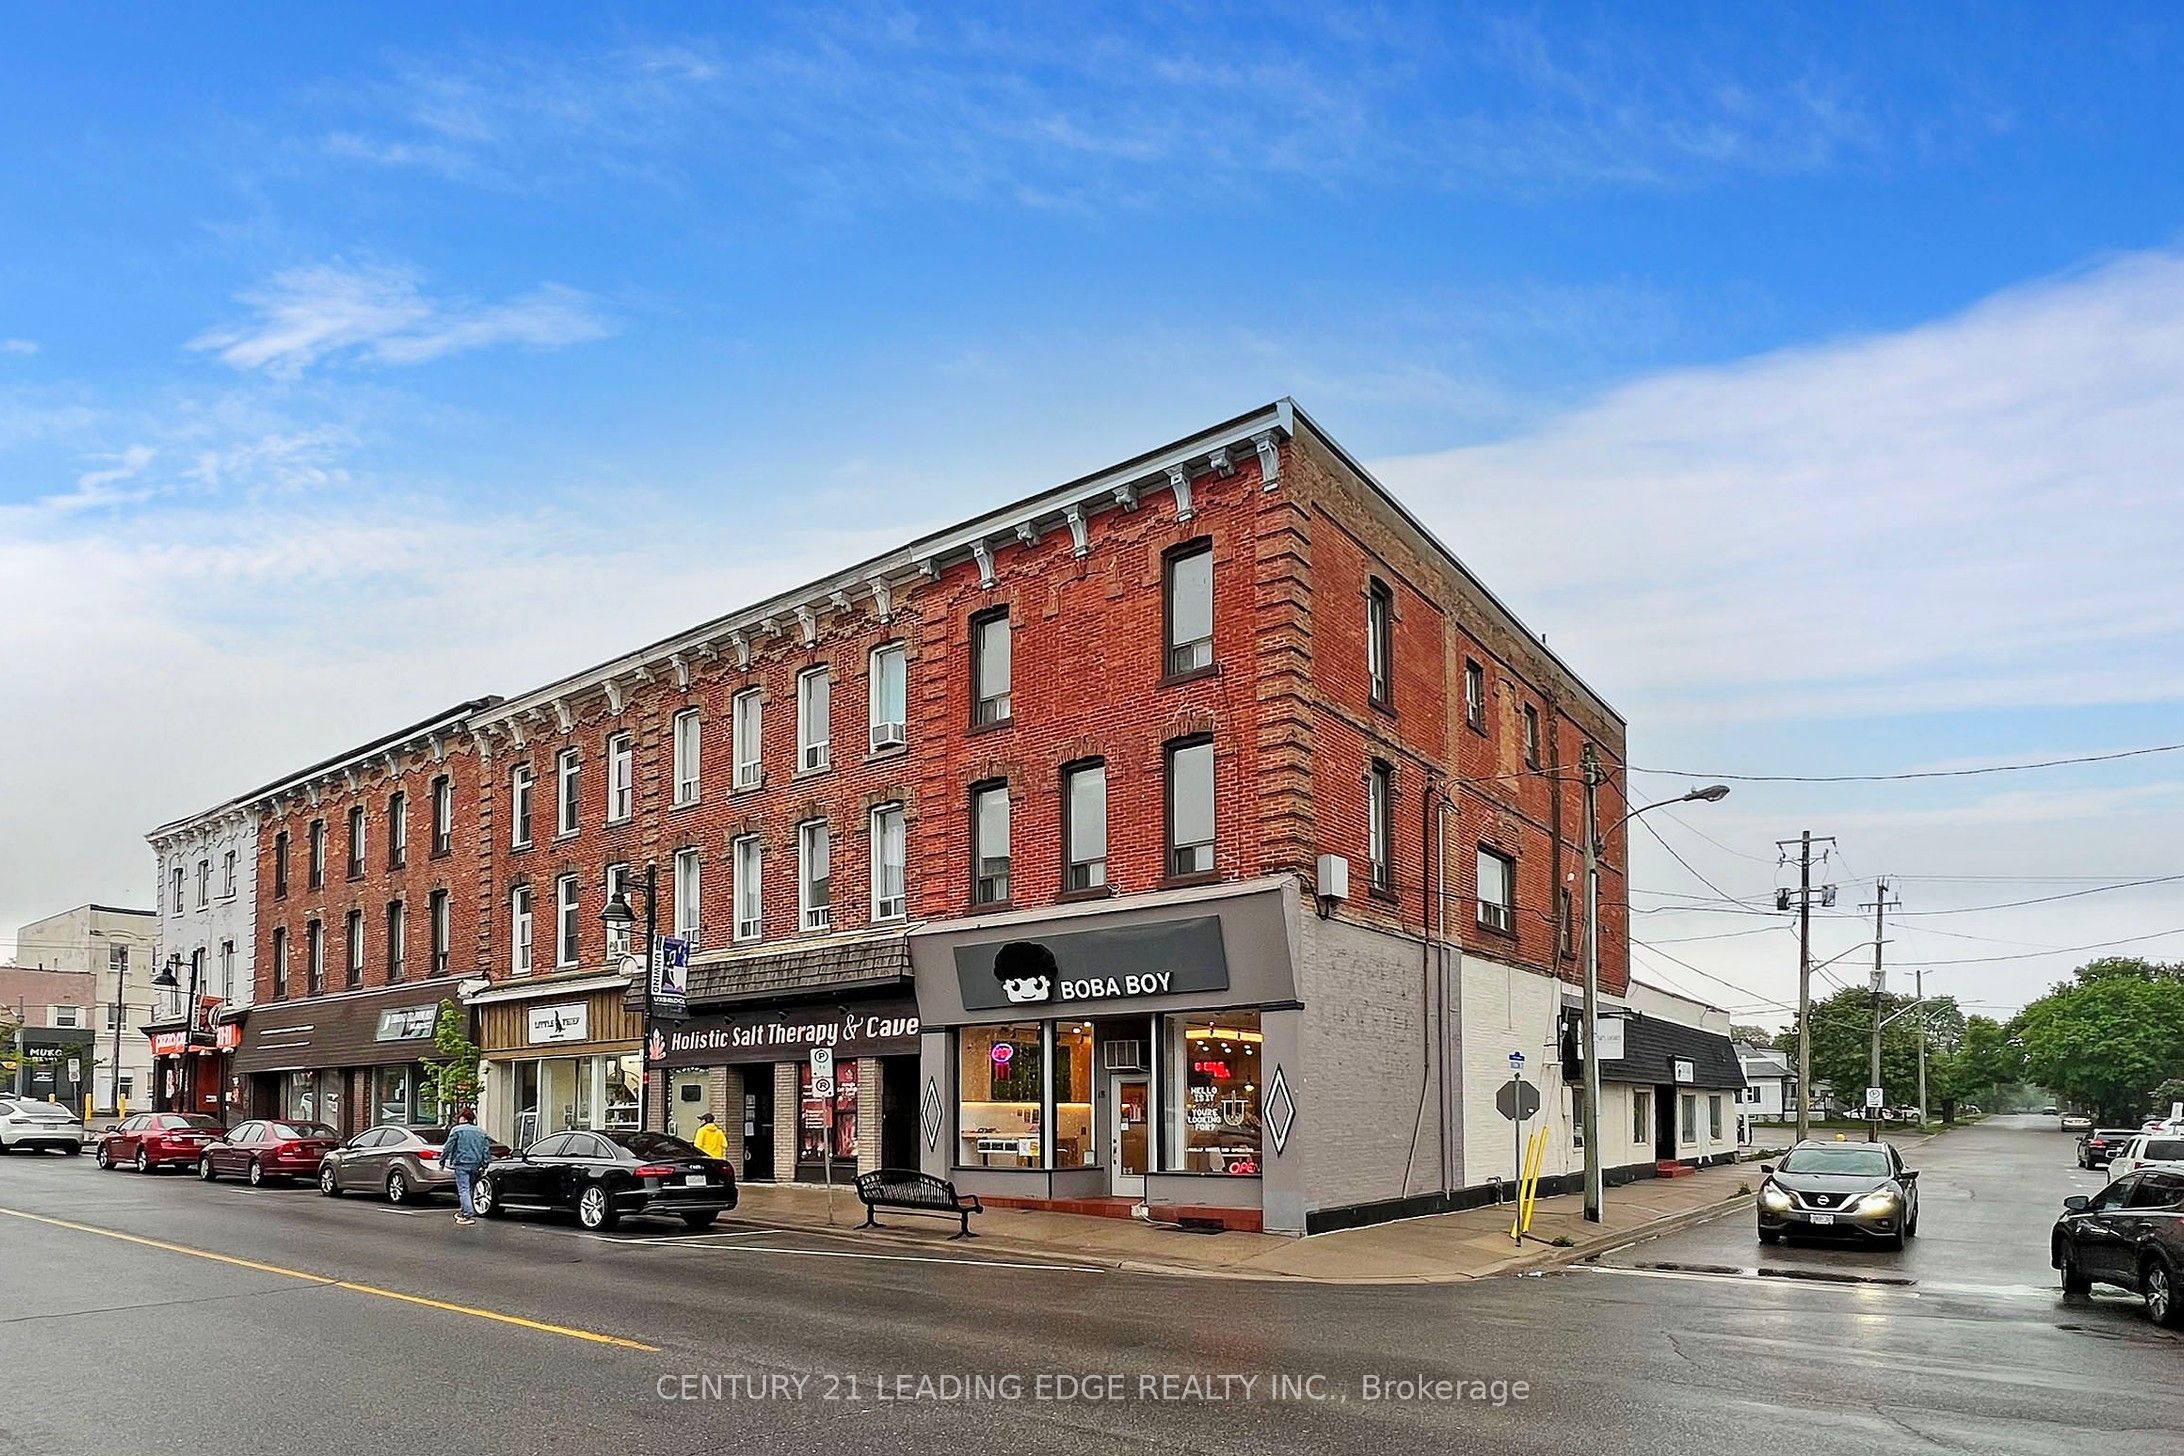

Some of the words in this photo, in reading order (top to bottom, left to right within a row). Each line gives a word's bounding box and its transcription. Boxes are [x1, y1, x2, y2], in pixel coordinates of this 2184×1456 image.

[1060, 977, 1121, 1000] BOBA
[1125, 971, 1171, 995] BOY
[671, 1029, 729, 1051] Holistic
[731, 1024, 764, 1047] Salt
[767, 1023, 839, 1047] Therapy
[842, 1014, 864, 1041] &
[865, 1016, 919, 1038] Cave
[1190, 1086, 1218, 1095] HELLO
[1194, 1094, 1204, 1102] IS
[1205, 1094, 1215, 1102] IT
[1187, 1115, 1222, 1124] LOOKING
